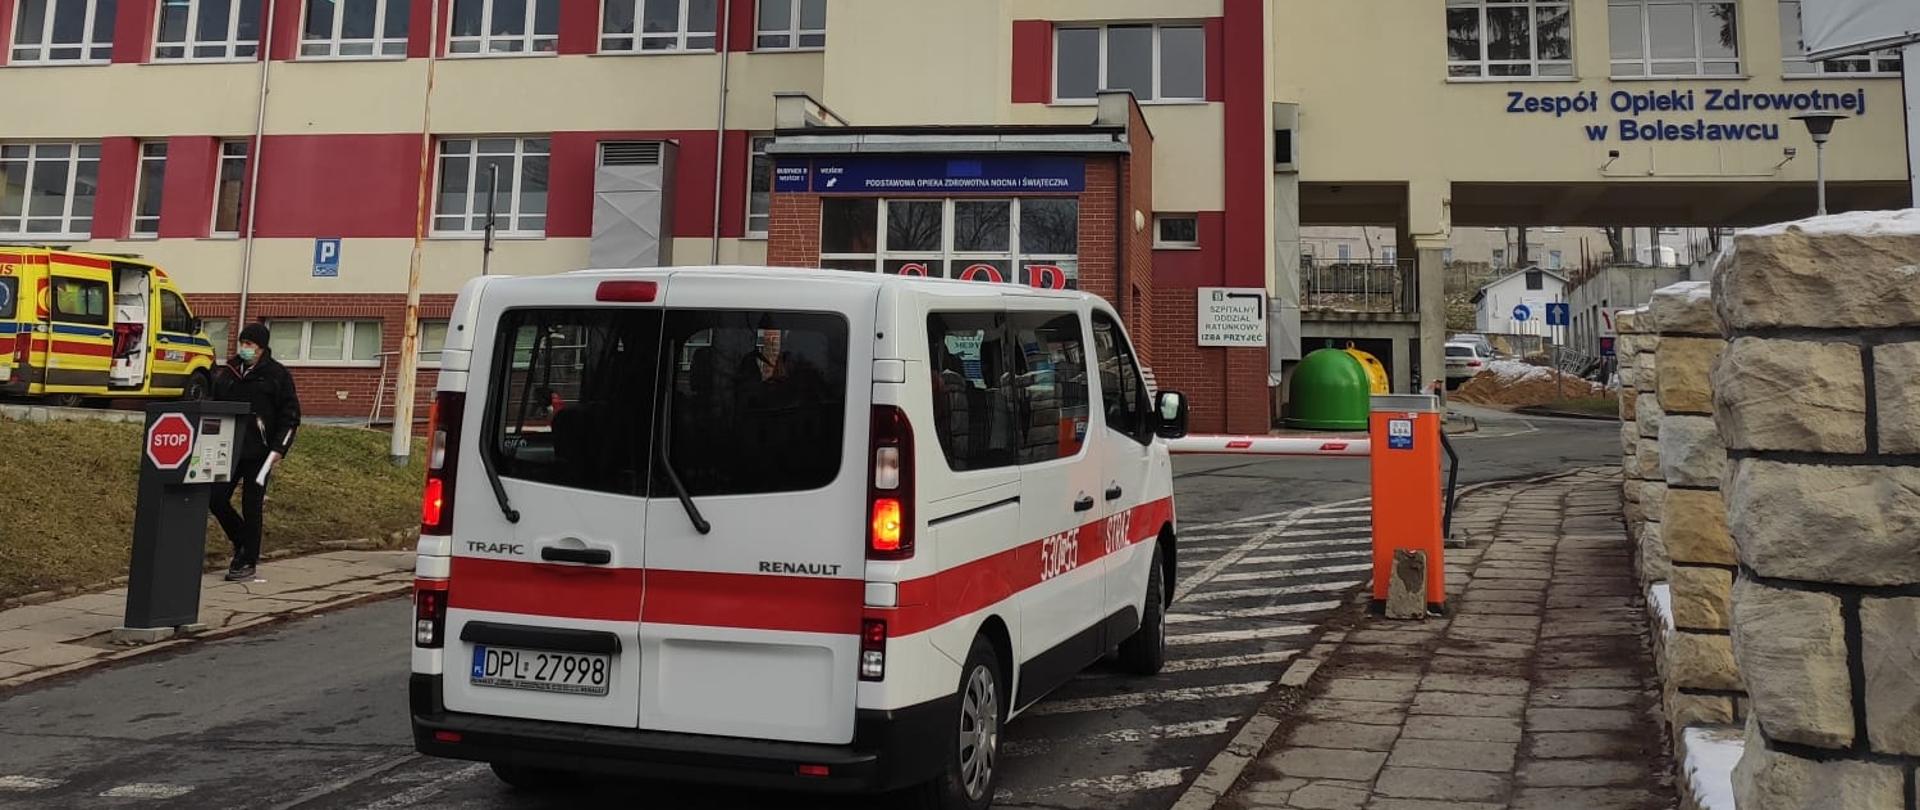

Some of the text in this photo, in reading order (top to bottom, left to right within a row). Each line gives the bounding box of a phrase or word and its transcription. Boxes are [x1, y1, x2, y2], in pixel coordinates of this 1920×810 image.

[1507, 88, 1866, 117] Zespół Opieki Zdrowotnej
[1585, 119, 1779, 141] w Bolesławcu
[865, 179, 915, 187] PODSTAWOWA
[917, 178, 943, 187] OPIEKA
[945, 178, 989, 187] ZDROWOTNA
[991, 178, 1017, 187] NOCNA
[321, 242, 335, 262] P
[154, 434, 187, 447] STOP
[466, 540, 525, 555] TRAFIC
[759, 561, 842, 575] RENAULT
[485, 649, 526, 679] DPL
[534, 653, 605, 685] 27998
